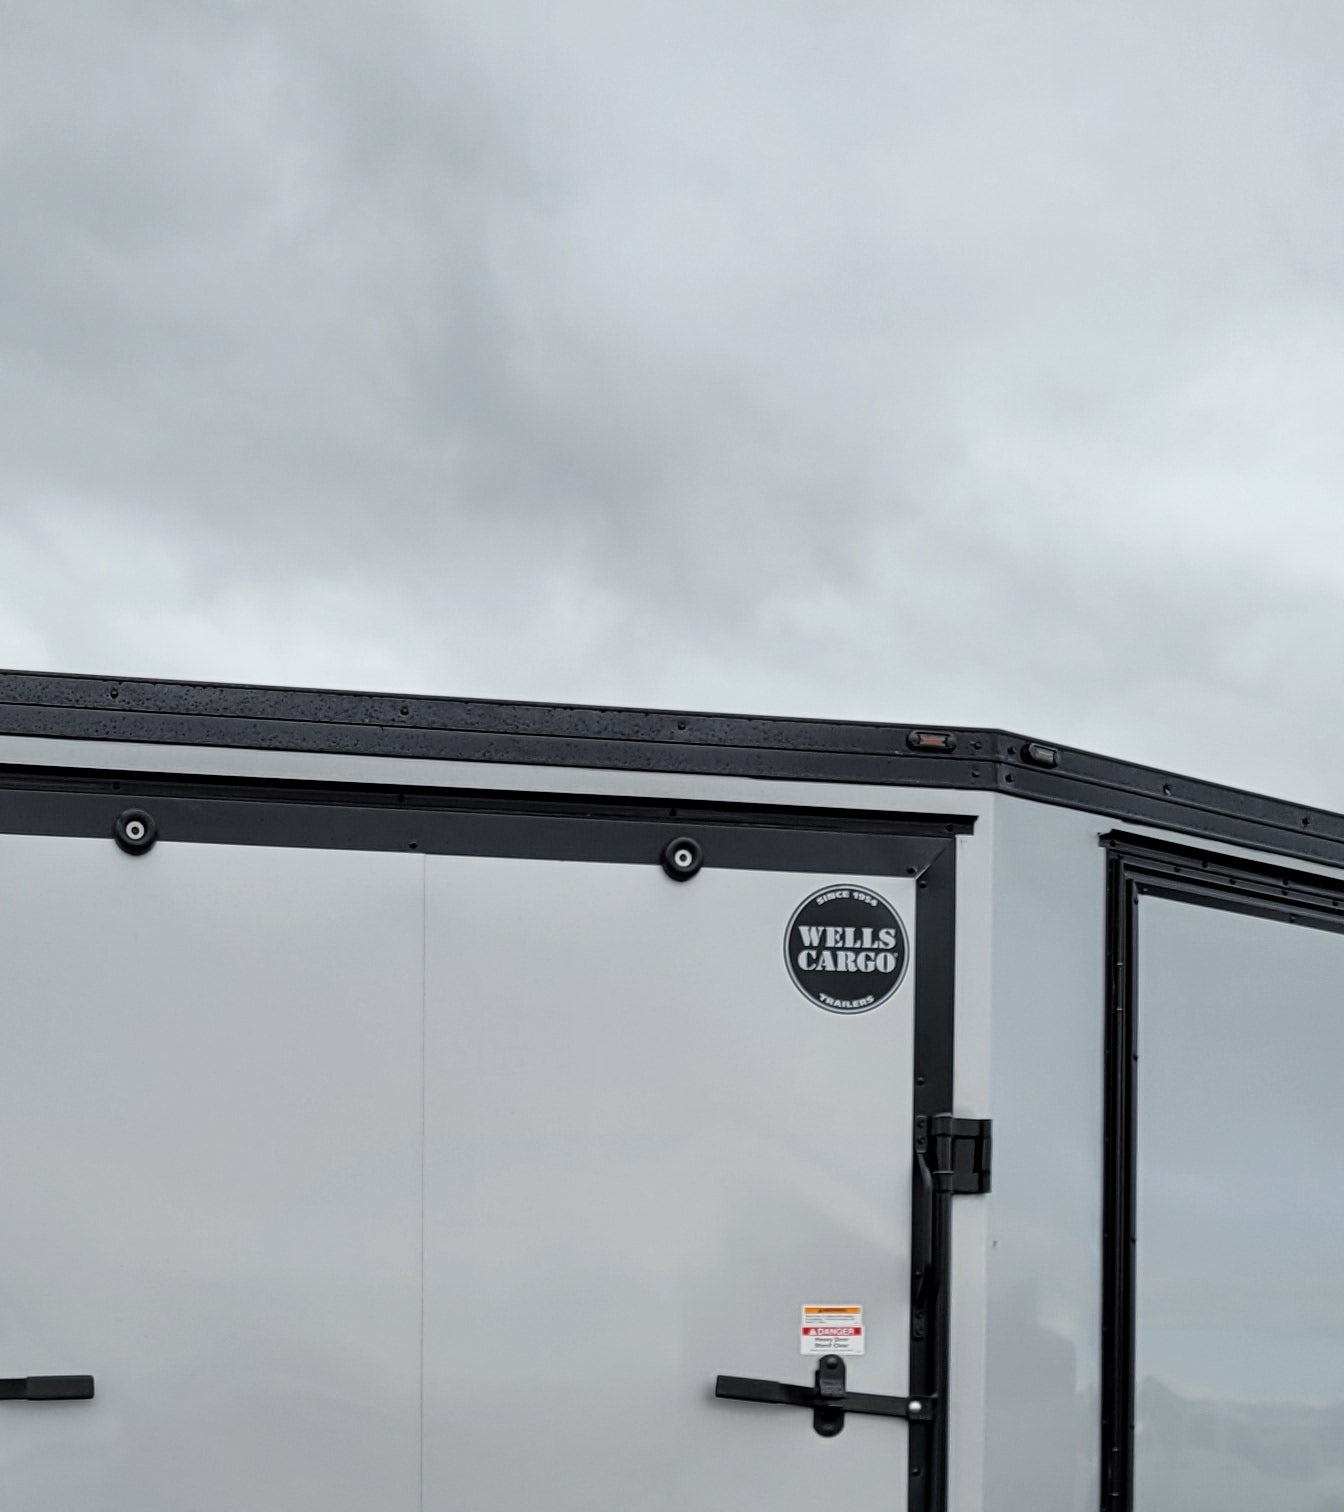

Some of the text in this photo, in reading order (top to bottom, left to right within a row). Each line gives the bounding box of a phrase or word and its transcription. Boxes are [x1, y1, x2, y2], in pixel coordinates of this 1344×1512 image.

[816, 891, 878, 907] SINCE 1954
[798, 925, 896, 949] WELLS
[797, 950, 897, 973] CARGO
[818, 993, 875, 1008] TRAILERS
[817, 1328, 855, 1336] DANGER
